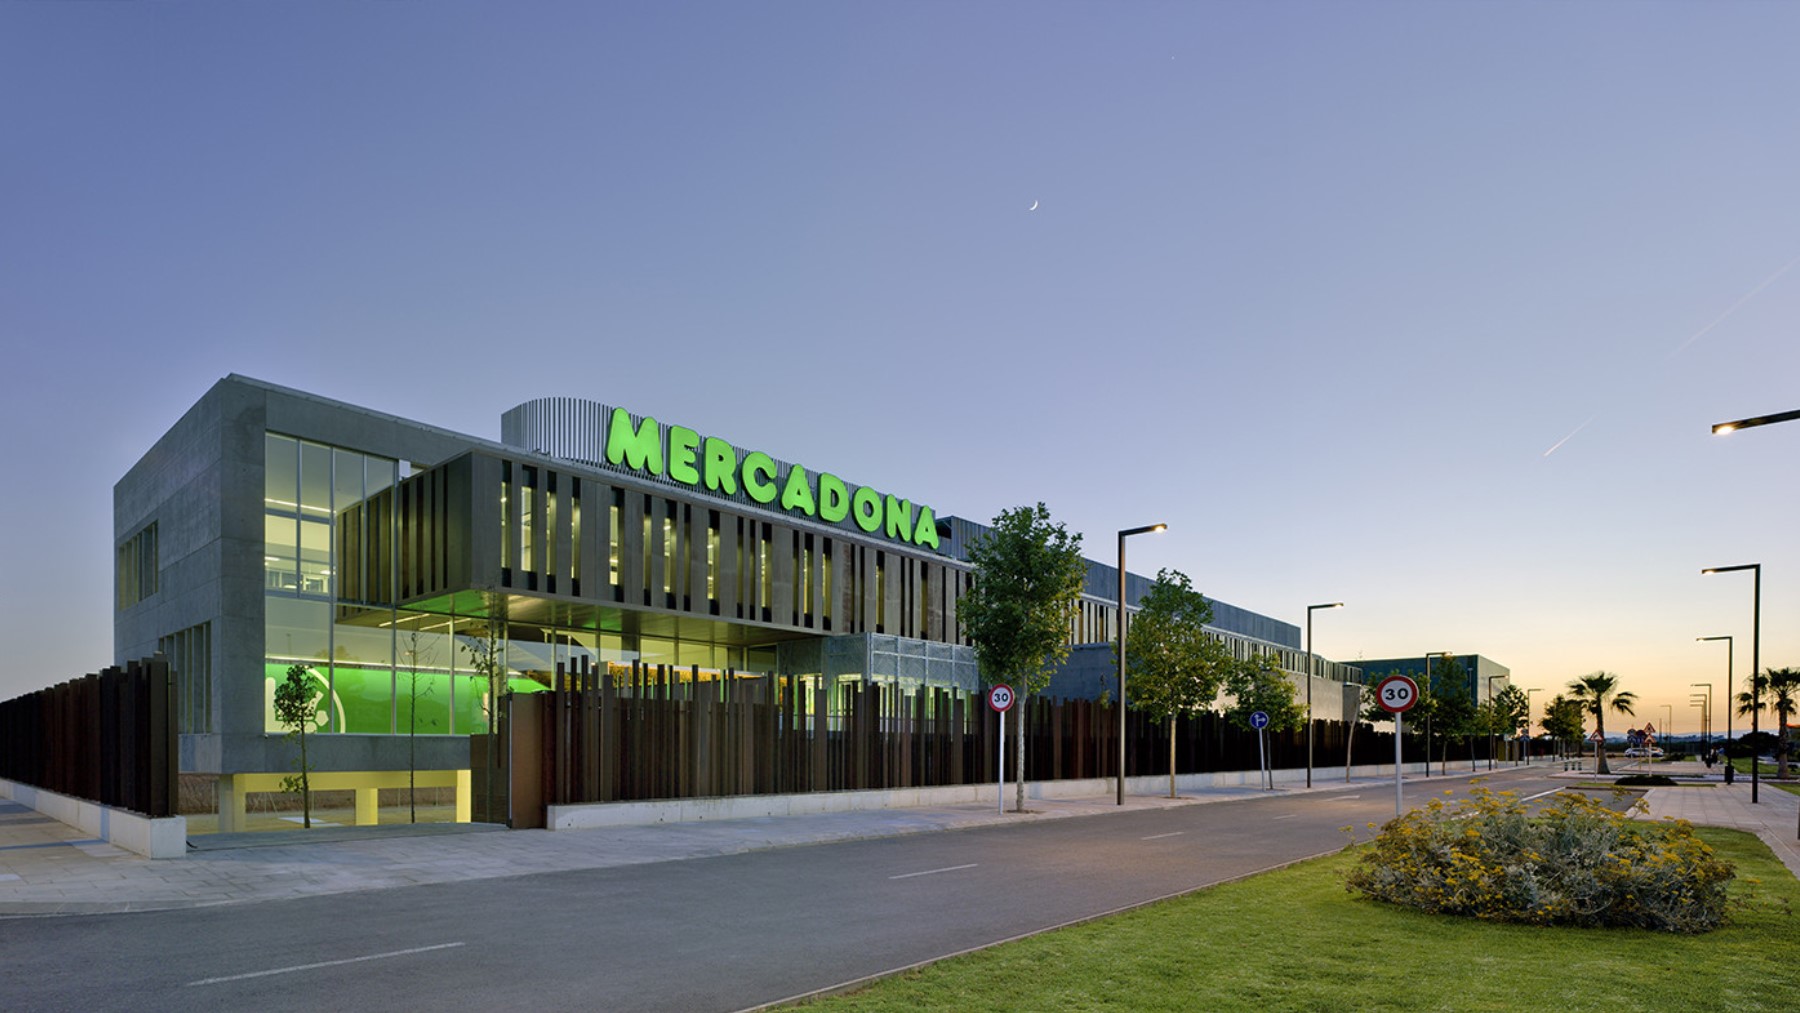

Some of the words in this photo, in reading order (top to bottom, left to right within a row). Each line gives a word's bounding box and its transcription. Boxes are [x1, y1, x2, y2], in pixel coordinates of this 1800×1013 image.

[606, 406, 940, 550] MERCADONA
[994, 693, 1009, 702] 30
[1385, 688, 1409, 701] 30
